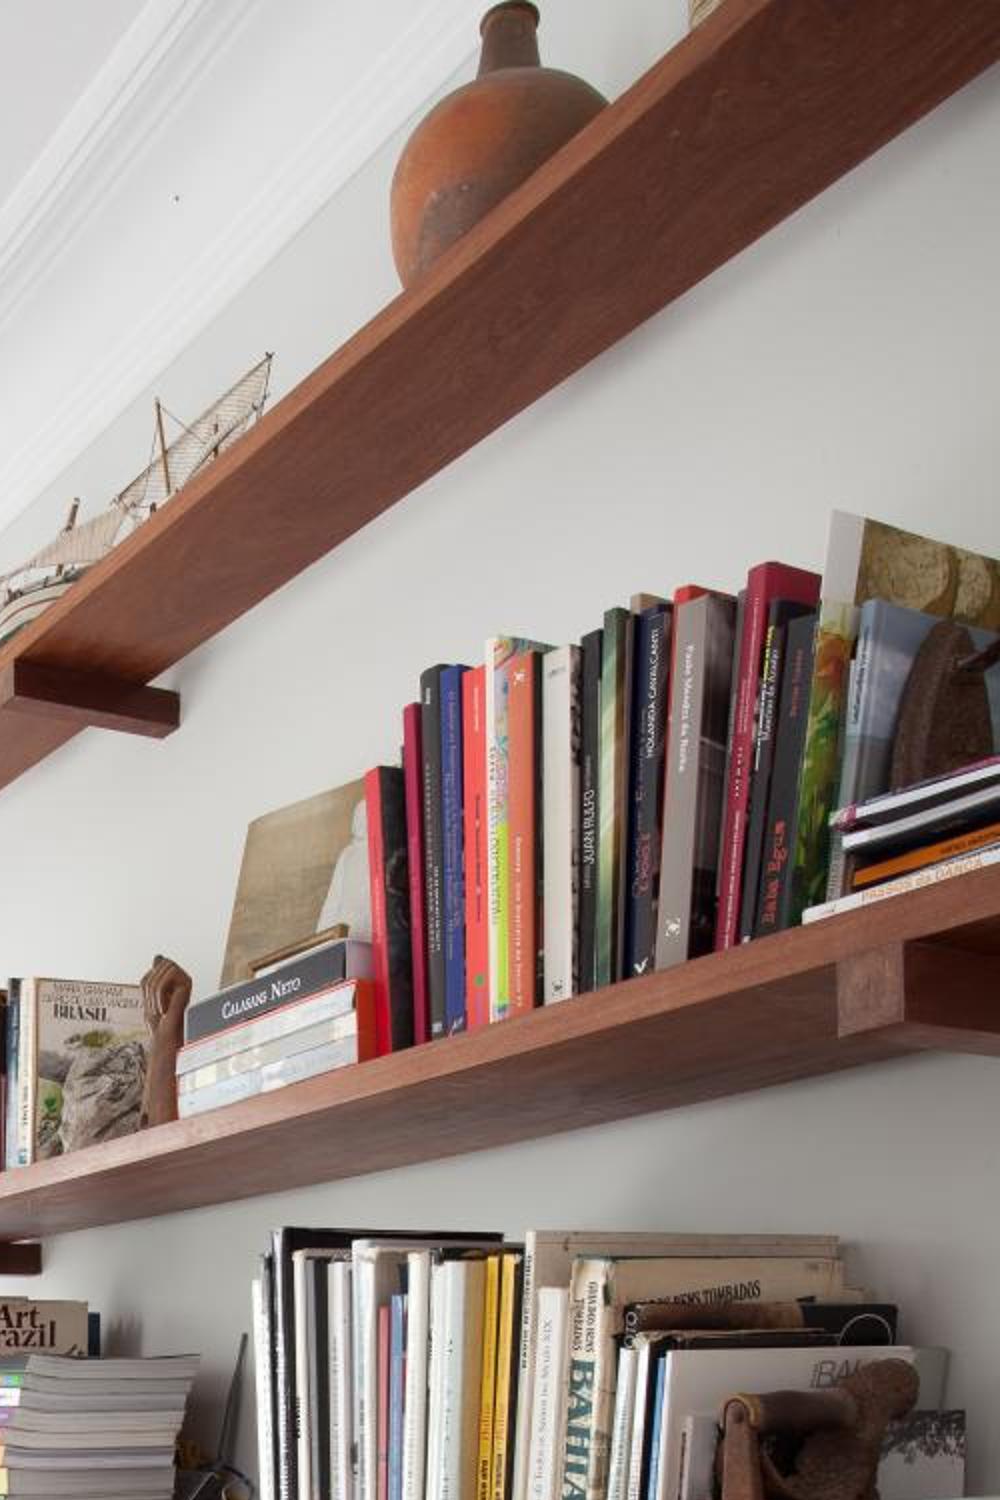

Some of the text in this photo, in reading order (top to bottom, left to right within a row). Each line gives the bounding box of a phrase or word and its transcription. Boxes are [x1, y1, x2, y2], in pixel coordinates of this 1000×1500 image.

[650, 629, 662, 698] CAVALCANTI
[645, 701, 657, 758] HOLANDA
[584, 788, 595, 826] RULFO
[584, 829, 595, 865] JUAN
[270, 977, 302, 1001] NETO
[53, 1003, 110, 1022] BRASIL
[703, 1279, 762, 1303] TOMBADOS
